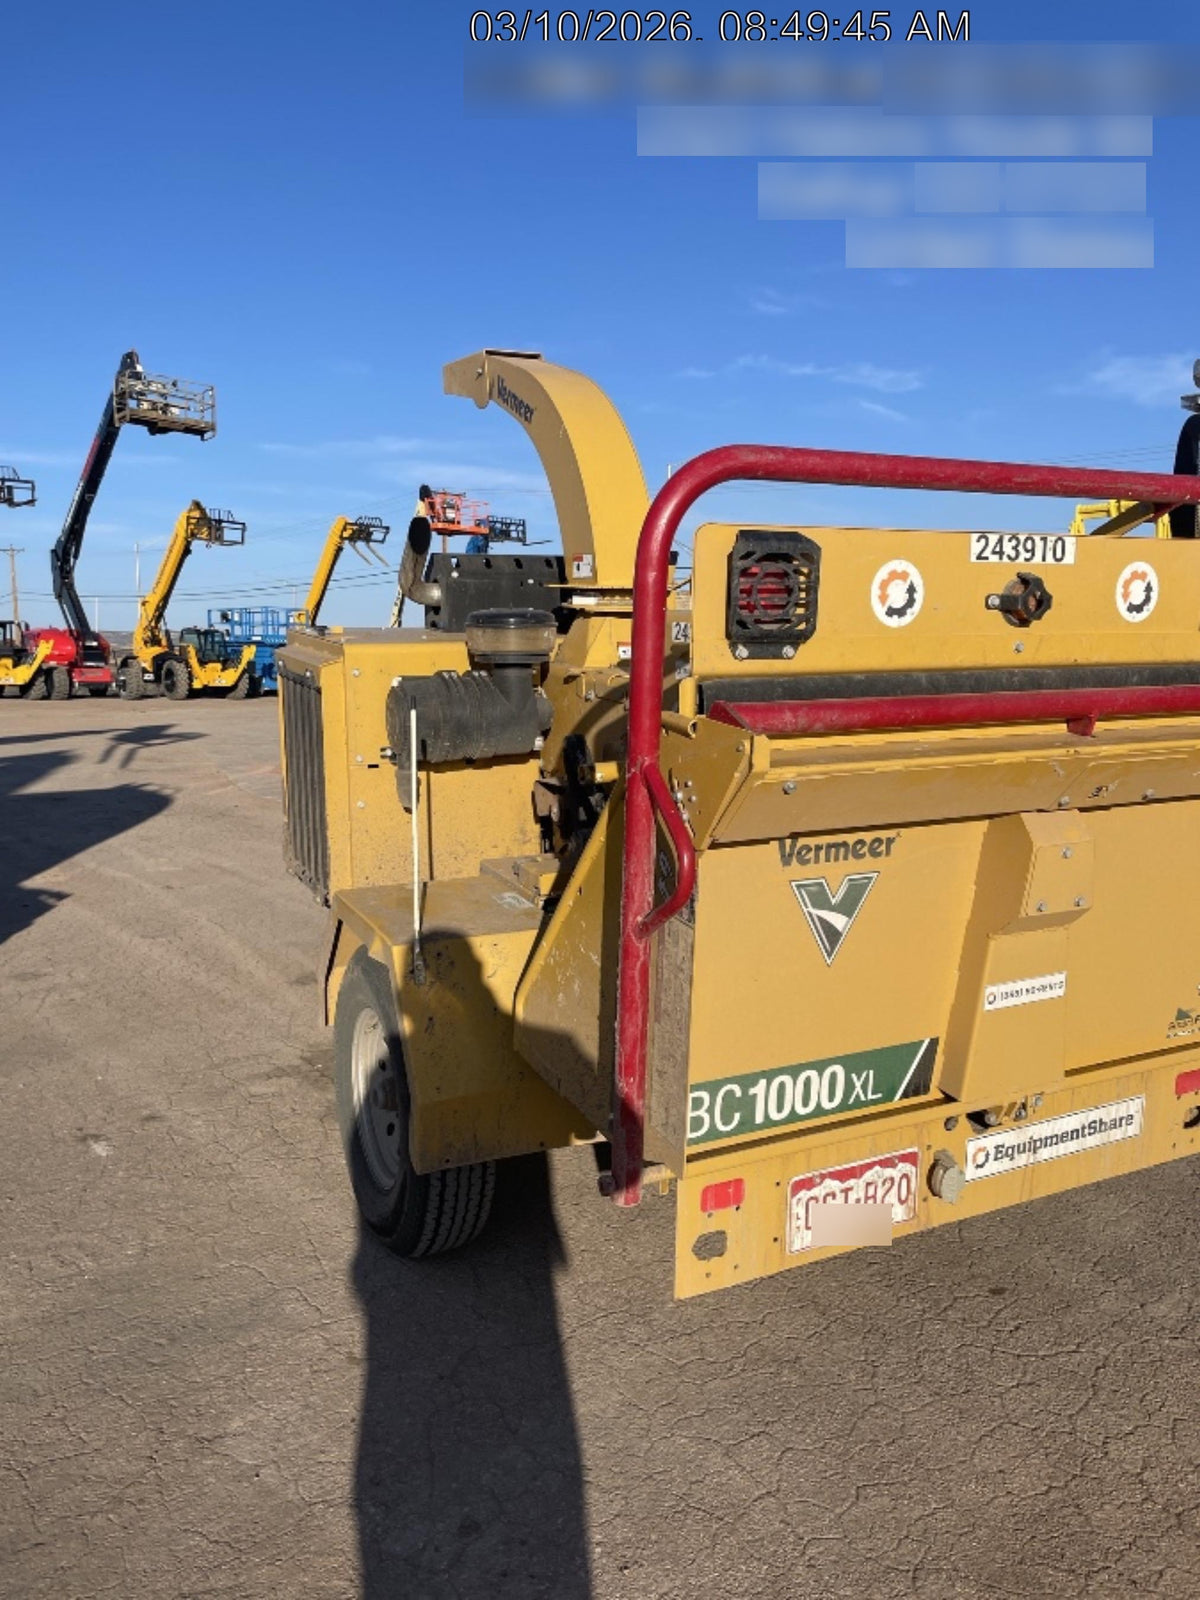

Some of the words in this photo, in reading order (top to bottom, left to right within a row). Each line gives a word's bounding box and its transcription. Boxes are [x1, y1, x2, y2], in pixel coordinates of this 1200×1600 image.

[497, 375, 535, 424] Vermeer
[975, 534, 1066, 562] 243910
[778, 836, 897, 868] Vermeer
[992, 1113, 1135, 1162] EquipmentShare
